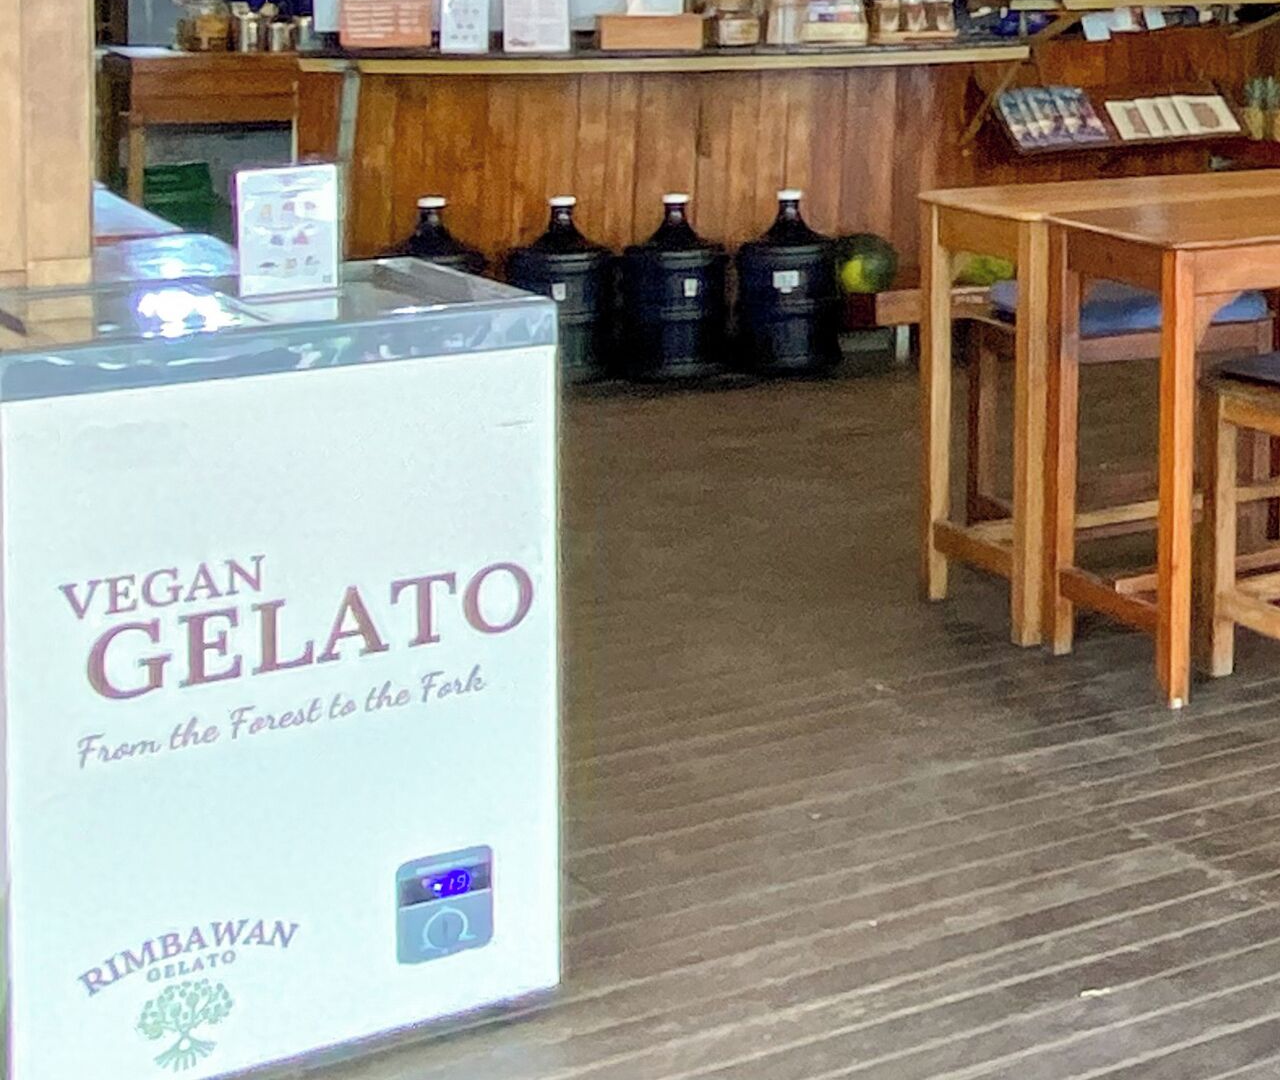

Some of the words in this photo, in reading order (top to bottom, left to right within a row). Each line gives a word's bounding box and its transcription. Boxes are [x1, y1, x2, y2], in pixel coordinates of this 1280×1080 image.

[58, 554, 266, 620] VEGAN
[86, 561, 535, 701] GELATO
[77, 732, 163, 769] From
[168, 716, 221, 751] the
[229, 698, 324, 741] Forest
[328, 691, 358, 720] to
[363, 678, 412, 712] the
[419, 663, 488, 705] Fork
[76, 918, 300, 998] RIMBAWAN
[146, 949, 237, 984] GELATO
